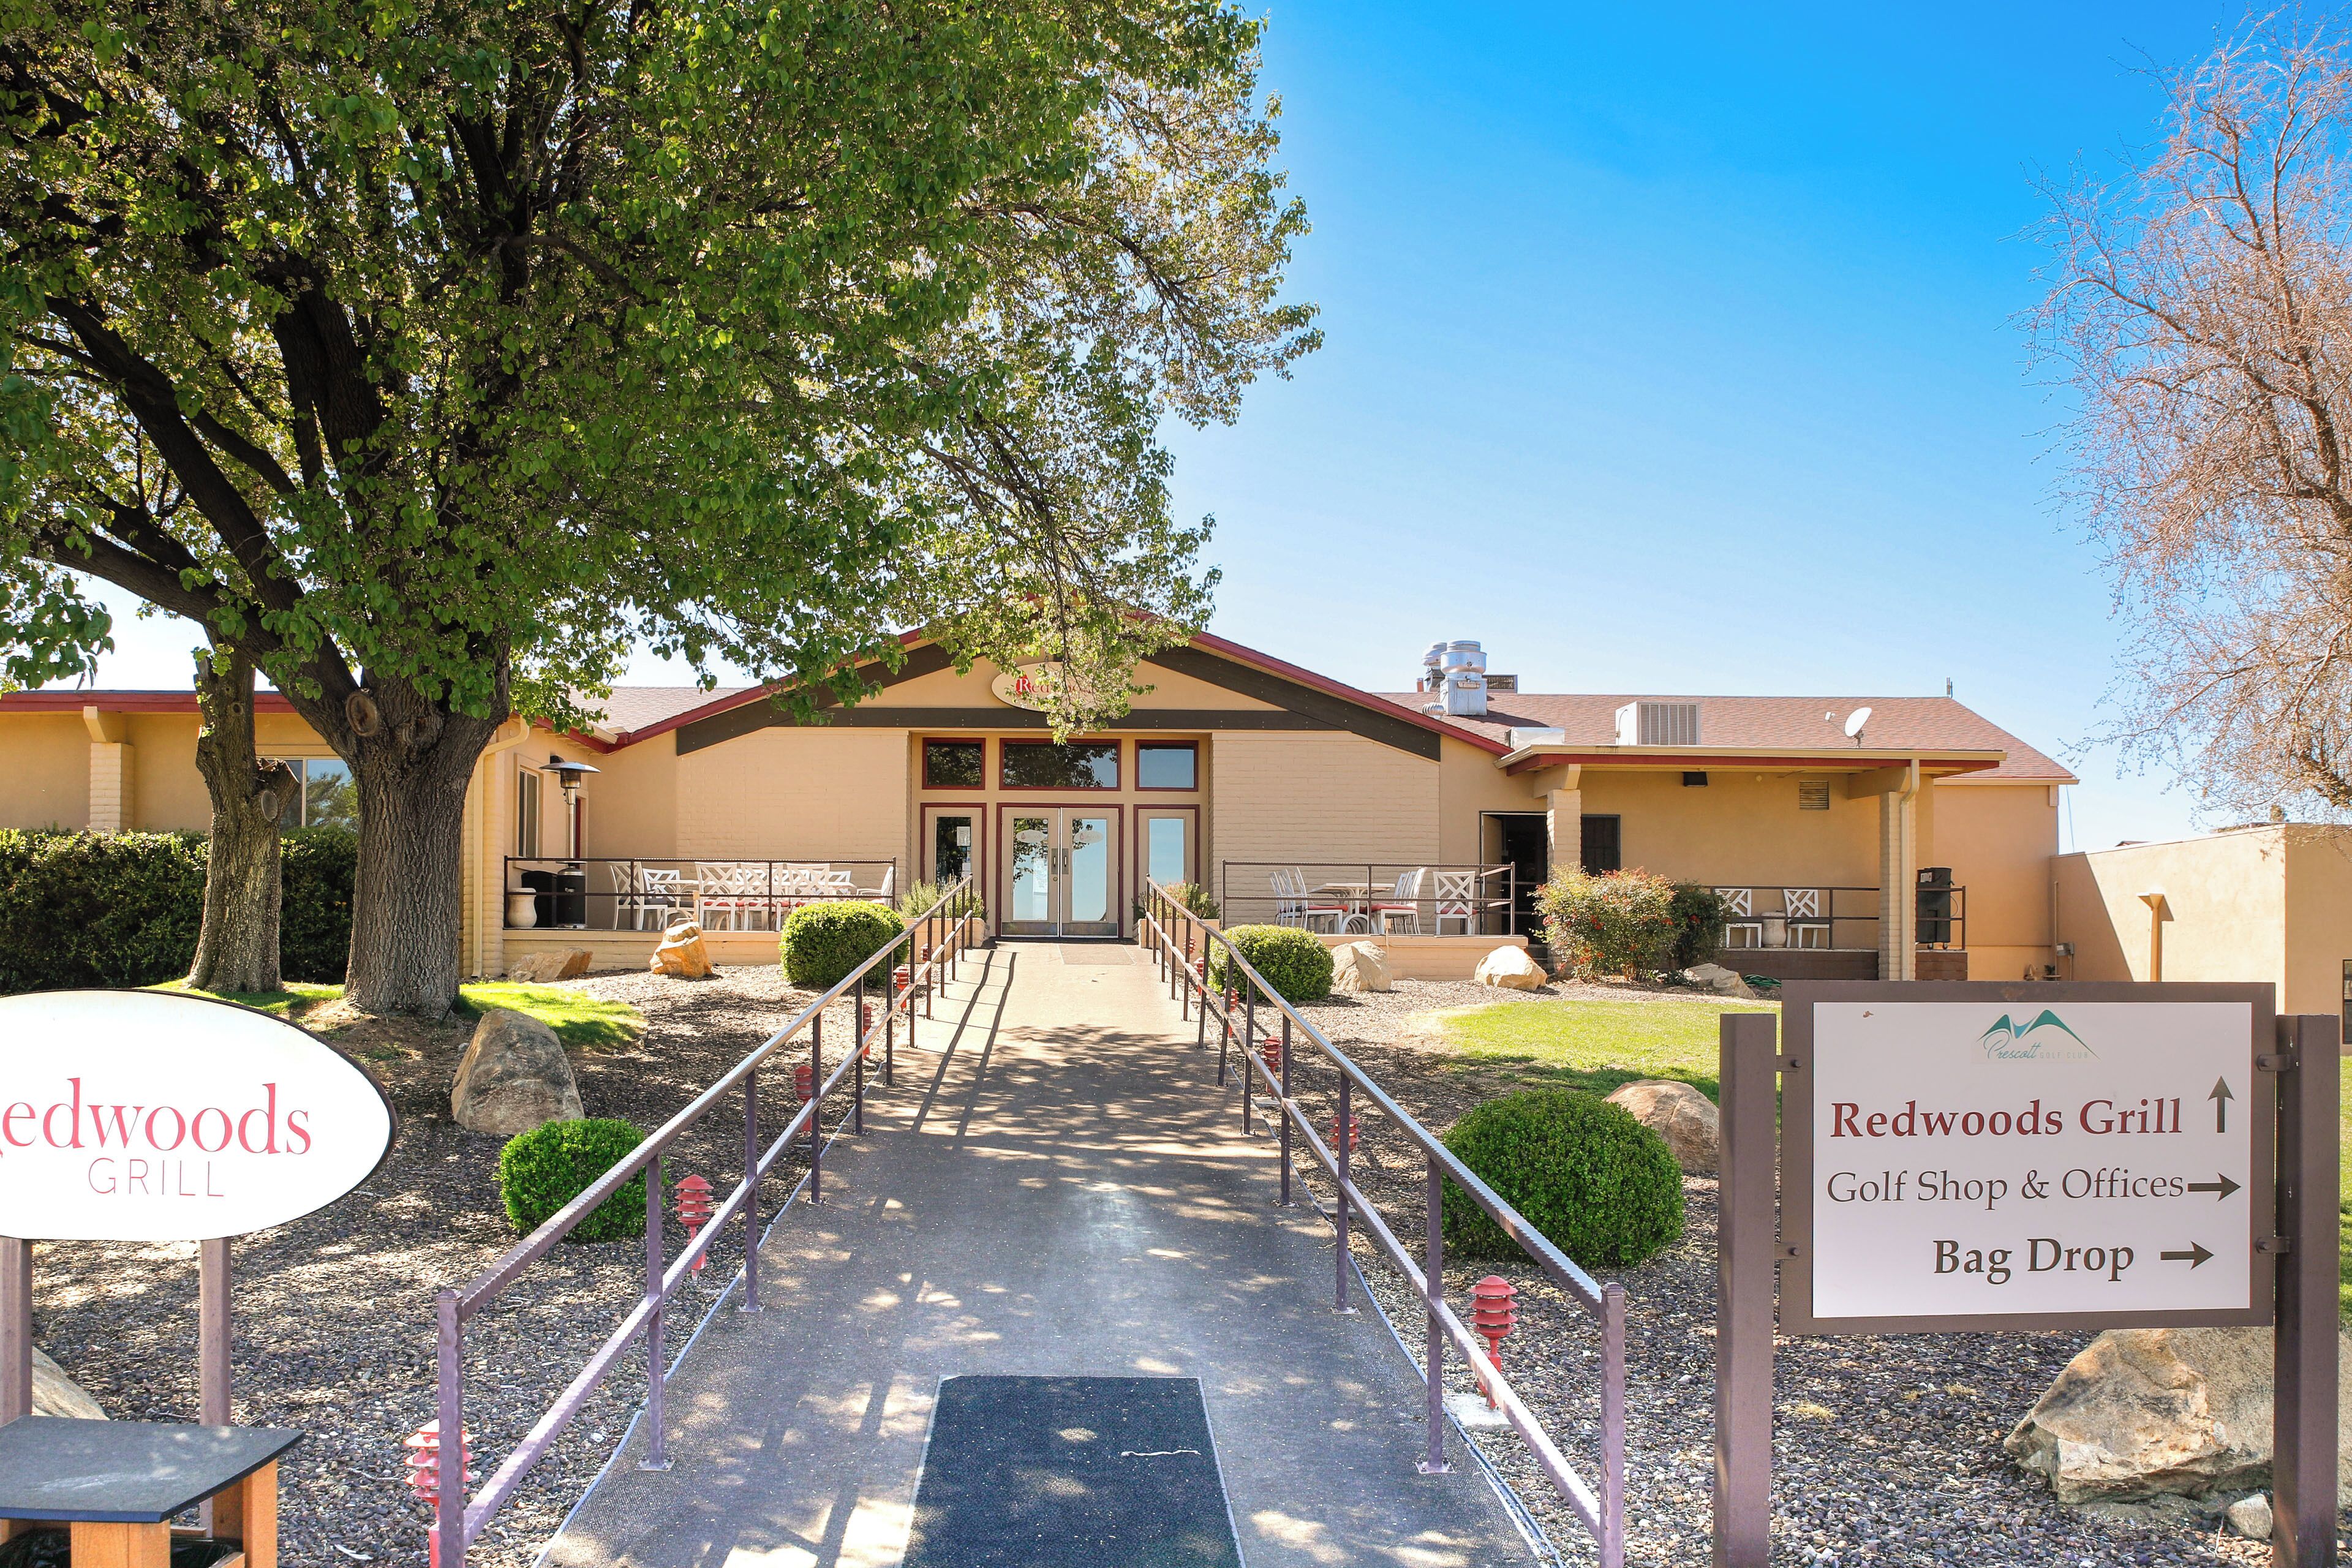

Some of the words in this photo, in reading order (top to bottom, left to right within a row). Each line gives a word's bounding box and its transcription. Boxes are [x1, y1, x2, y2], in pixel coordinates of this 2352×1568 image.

[1983, 1030, 2041, 1059] Prescott
[0, 1077, 311, 1157] edwoods
[1830, 1098, 2063, 1137] Redwoods
[2079, 1097, 2182, 1135] Grill
[88, 1157, 224, 1197] GRILL
[1827, 1170, 1908, 1202] Golf
[1918, 1169, 2008, 1211] Shop
[2021, 1169, 2049, 1200] &
[2062, 1167, 2184, 1199] Offices
[1932, 1240, 2013, 1285] Bag
[2027, 1238, 2134, 1282] Drop
